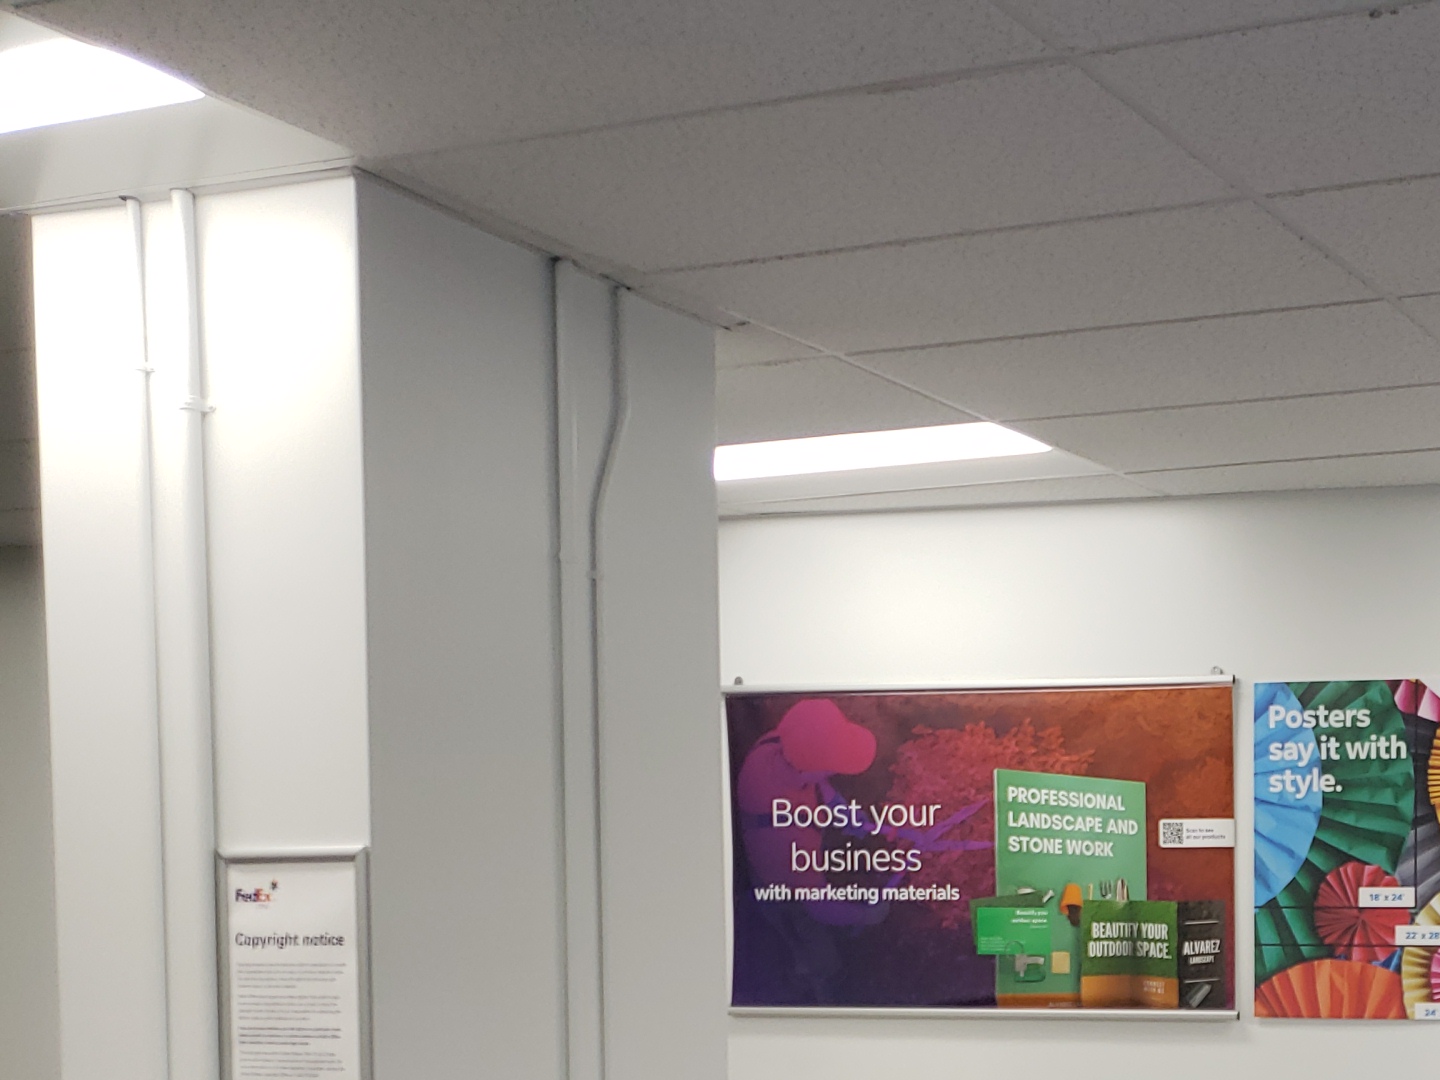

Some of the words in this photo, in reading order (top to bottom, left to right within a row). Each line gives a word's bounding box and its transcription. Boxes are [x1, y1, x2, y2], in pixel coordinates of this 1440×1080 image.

[1269, 705, 1371, 729] Posters
[1269, 742, 1314, 767] say
[1320, 735, 1340, 761] it
[1345, 734, 1407, 760] with
[1269, 768, 1343, 799] style.
[1008, 786, 1126, 811] PROFESSIONAL
[772, 798, 862, 828] Boost
[870, 804, 941, 834] your
[1008, 811, 1103, 833] LANDSCAPE
[1106, 819, 1139, 835] AND
[791, 842, 922, 872] business
[1008, 836, 1062, 854] STONE
[1066, 839, 1114, 857] WORK
[754, 883, 791, 900] with
[795, 883, 879, 905] marketing
[882, 884, 960, 900] materials
[235, 932, 299, 949] Copyright
[302, 932, 345, 946] notice
[1092, 922, 1139, 939] BEAUTIFY
[1141, 923, 1168, 940] YOUR
[1088, 941, 1135, 958] OUTDOOR
[1136, 942, 1172, 959] SPACE.
[1182, 939, 1220, 956] ALVAREZ
